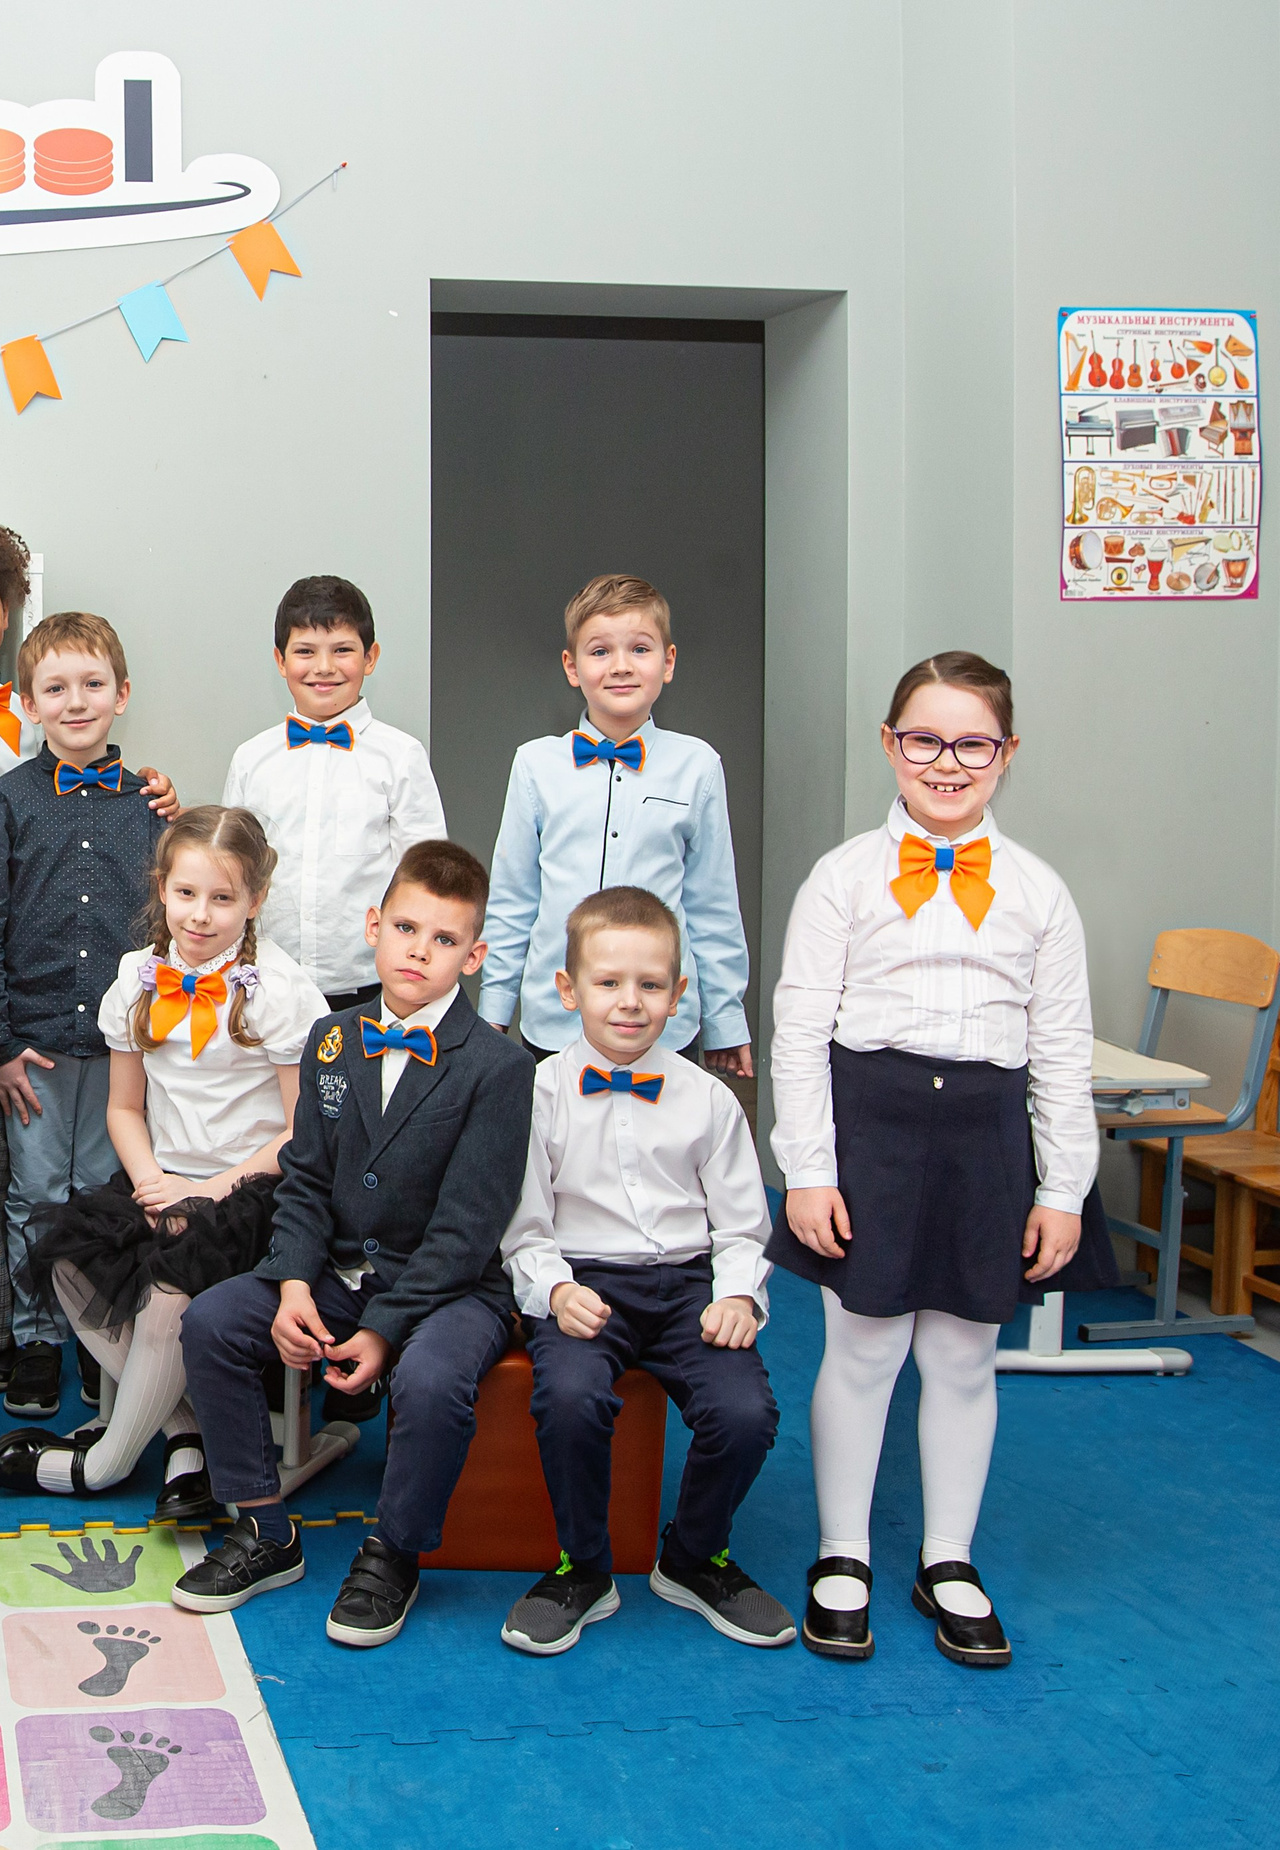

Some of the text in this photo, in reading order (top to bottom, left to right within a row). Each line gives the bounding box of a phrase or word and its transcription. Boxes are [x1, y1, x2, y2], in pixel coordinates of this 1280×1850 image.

[1077, 315, 1235, 327] МУЗЫКАЛЬНЫЕ ИНСТРУМЕНТЫ
[319, 1074, 344, 1087] BREAK
